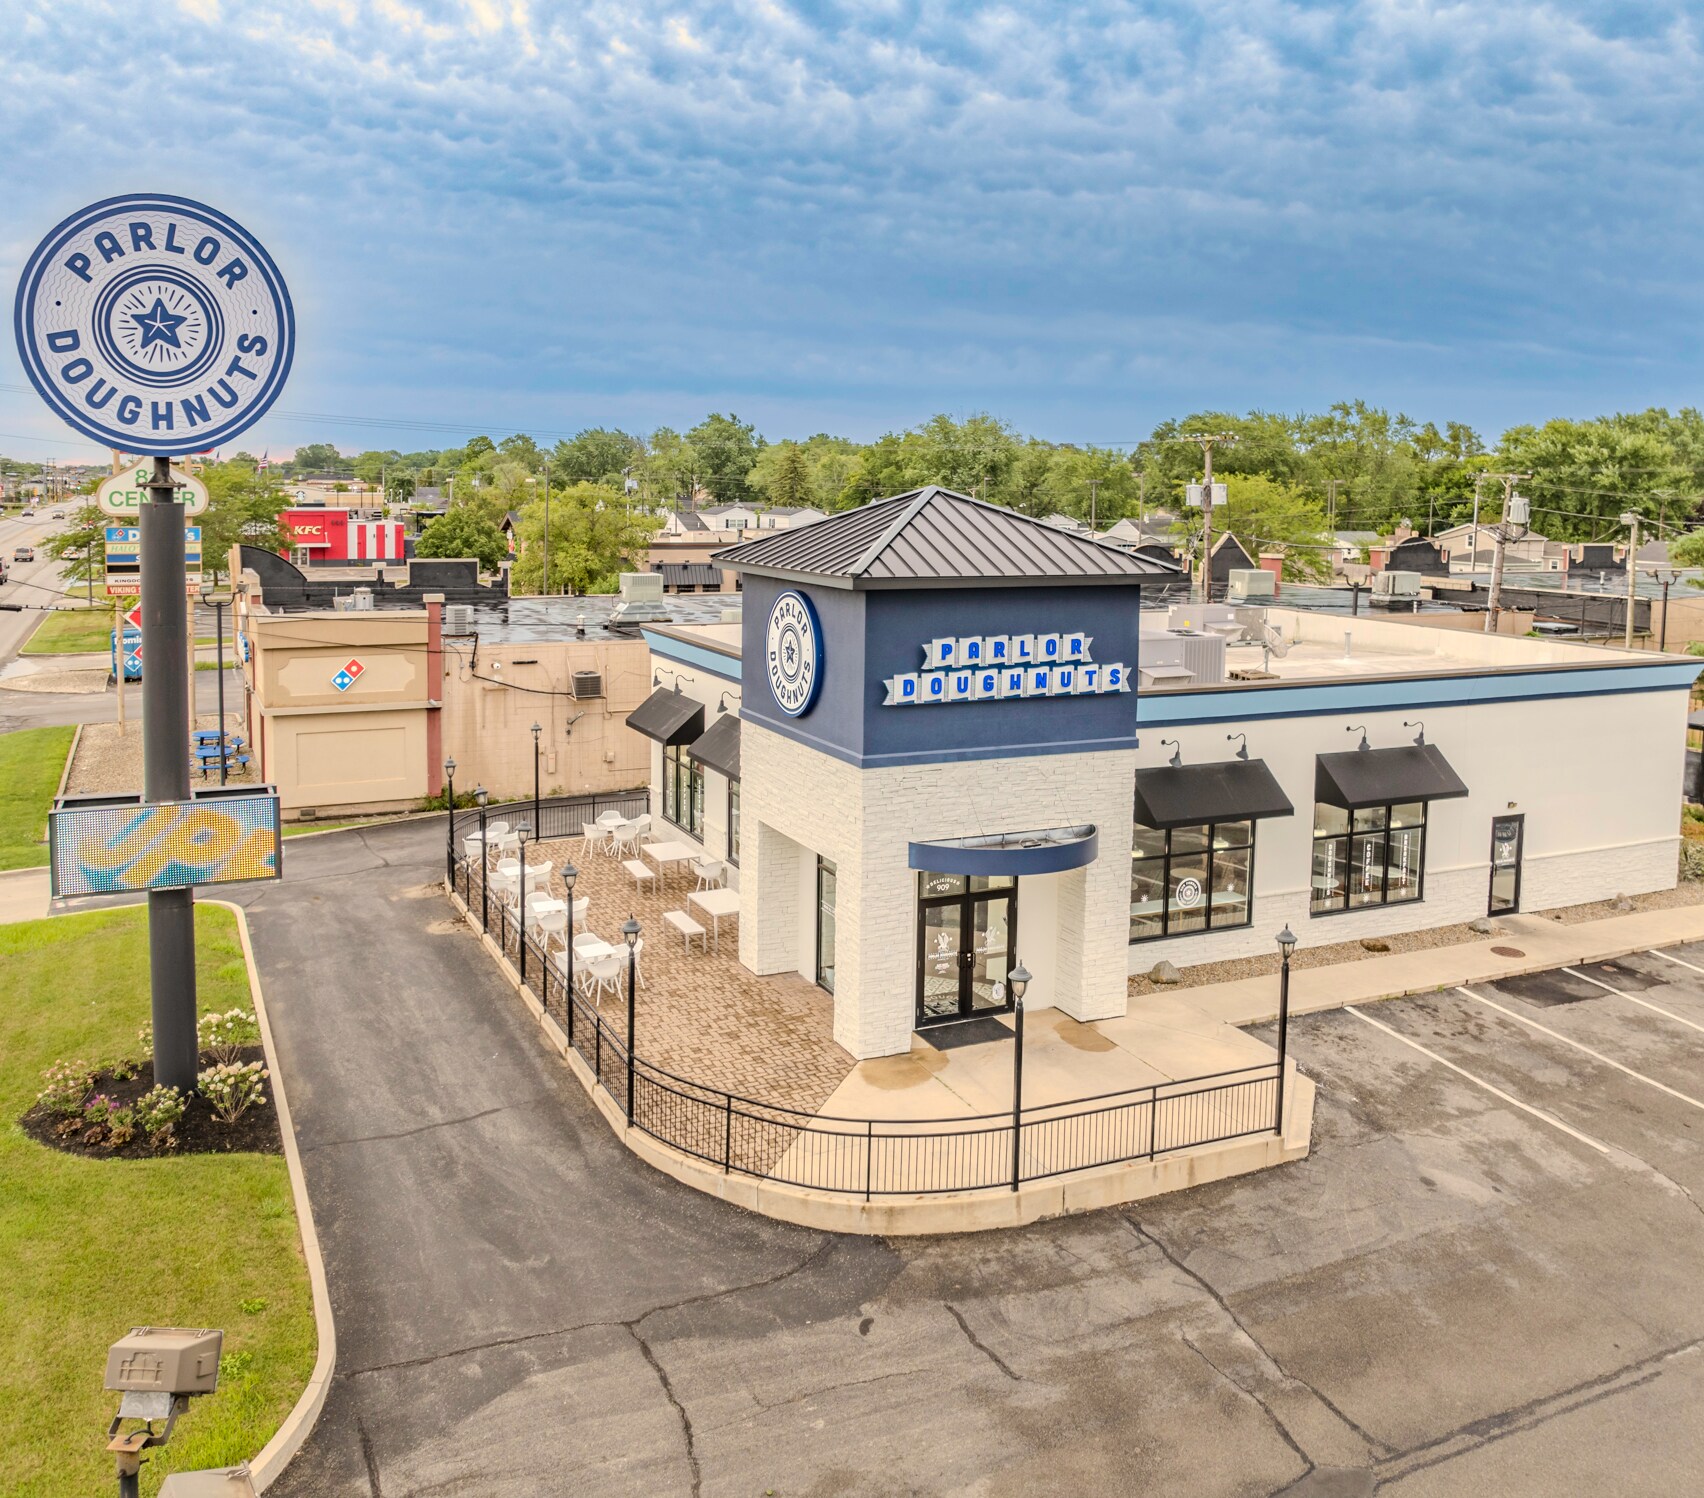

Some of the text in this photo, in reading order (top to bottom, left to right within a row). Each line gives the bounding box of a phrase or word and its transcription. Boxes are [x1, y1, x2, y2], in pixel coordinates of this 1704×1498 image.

[64, 222, 249, 291] PARLOR
[46, 328, 269, 431] DOUGHNUTS
[108, 490, 196, 508] CENER
[293, 525, 322, 535] KFC
[109, 586, 137, 594] VIKING
[773, 602, 808, 637] PARLOR
[940, 637, 1083, 661] PARLOR
[770, 651, 811, 705] DOUGHNUTS
[902, 668, 1122, 698] DOUGHNUTS
[1364, 844, 1372, 886] COFFEE
[936, 883, 950, 892] 909
